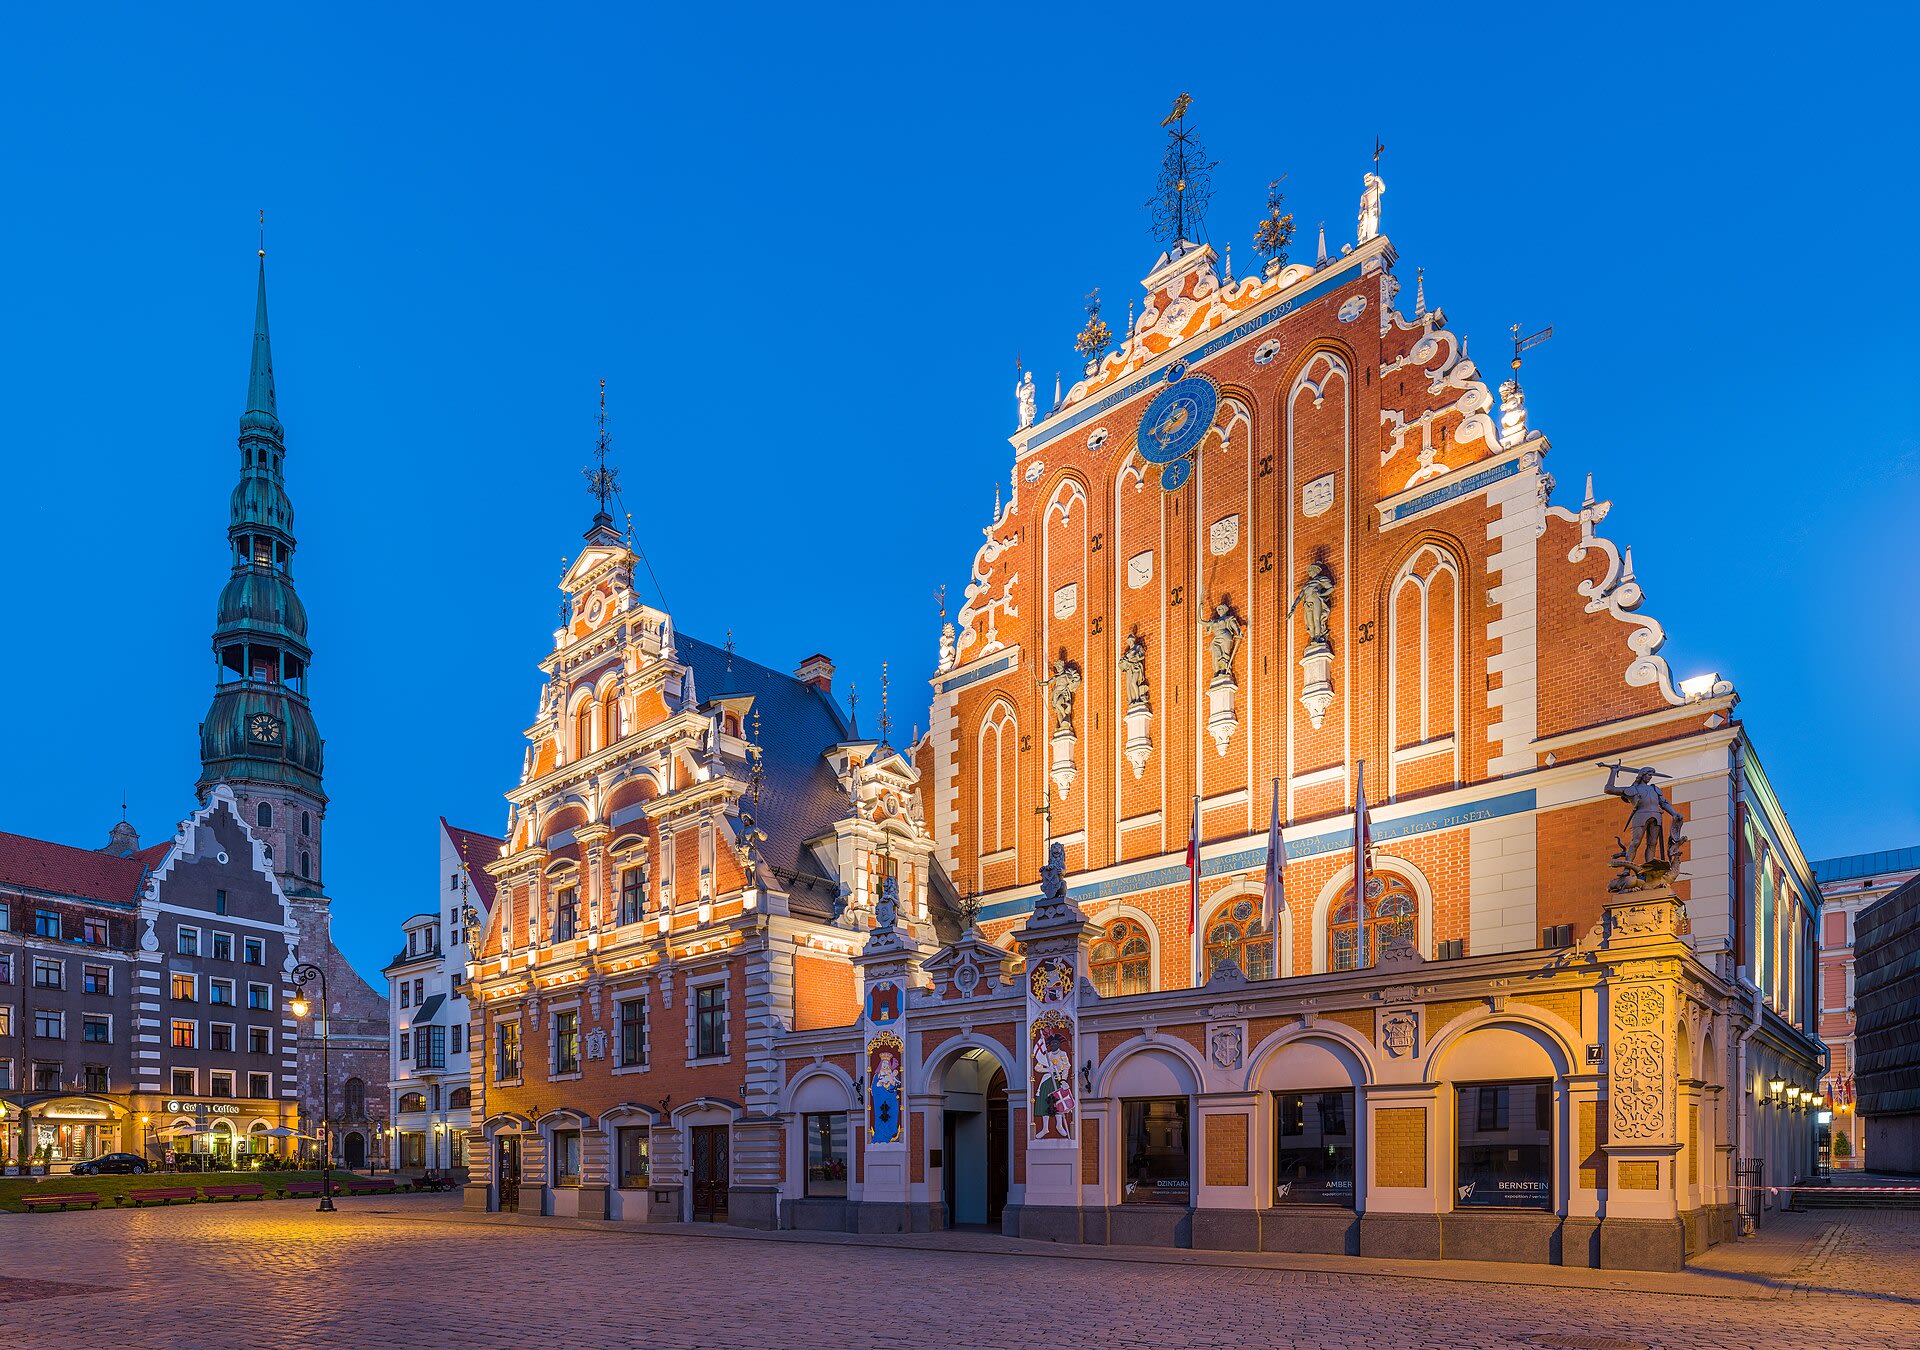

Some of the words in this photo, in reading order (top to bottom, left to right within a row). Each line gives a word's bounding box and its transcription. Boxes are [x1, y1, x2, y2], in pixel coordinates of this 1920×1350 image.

[1230, 316, 1263, 343] ANNO
[1266, 300, 1293, 323] 1999
[1098, 389, 1125, 410] ANNO
[1294, 846, 1311, 857] NO
[1099, 887, 1114, 897] PAR
[1591, 1048, 1599, 1058] 7
[212, 1104, 240, 1114] Coffee
[1498, 1181, 1549, 1190] BERNSTEIN
